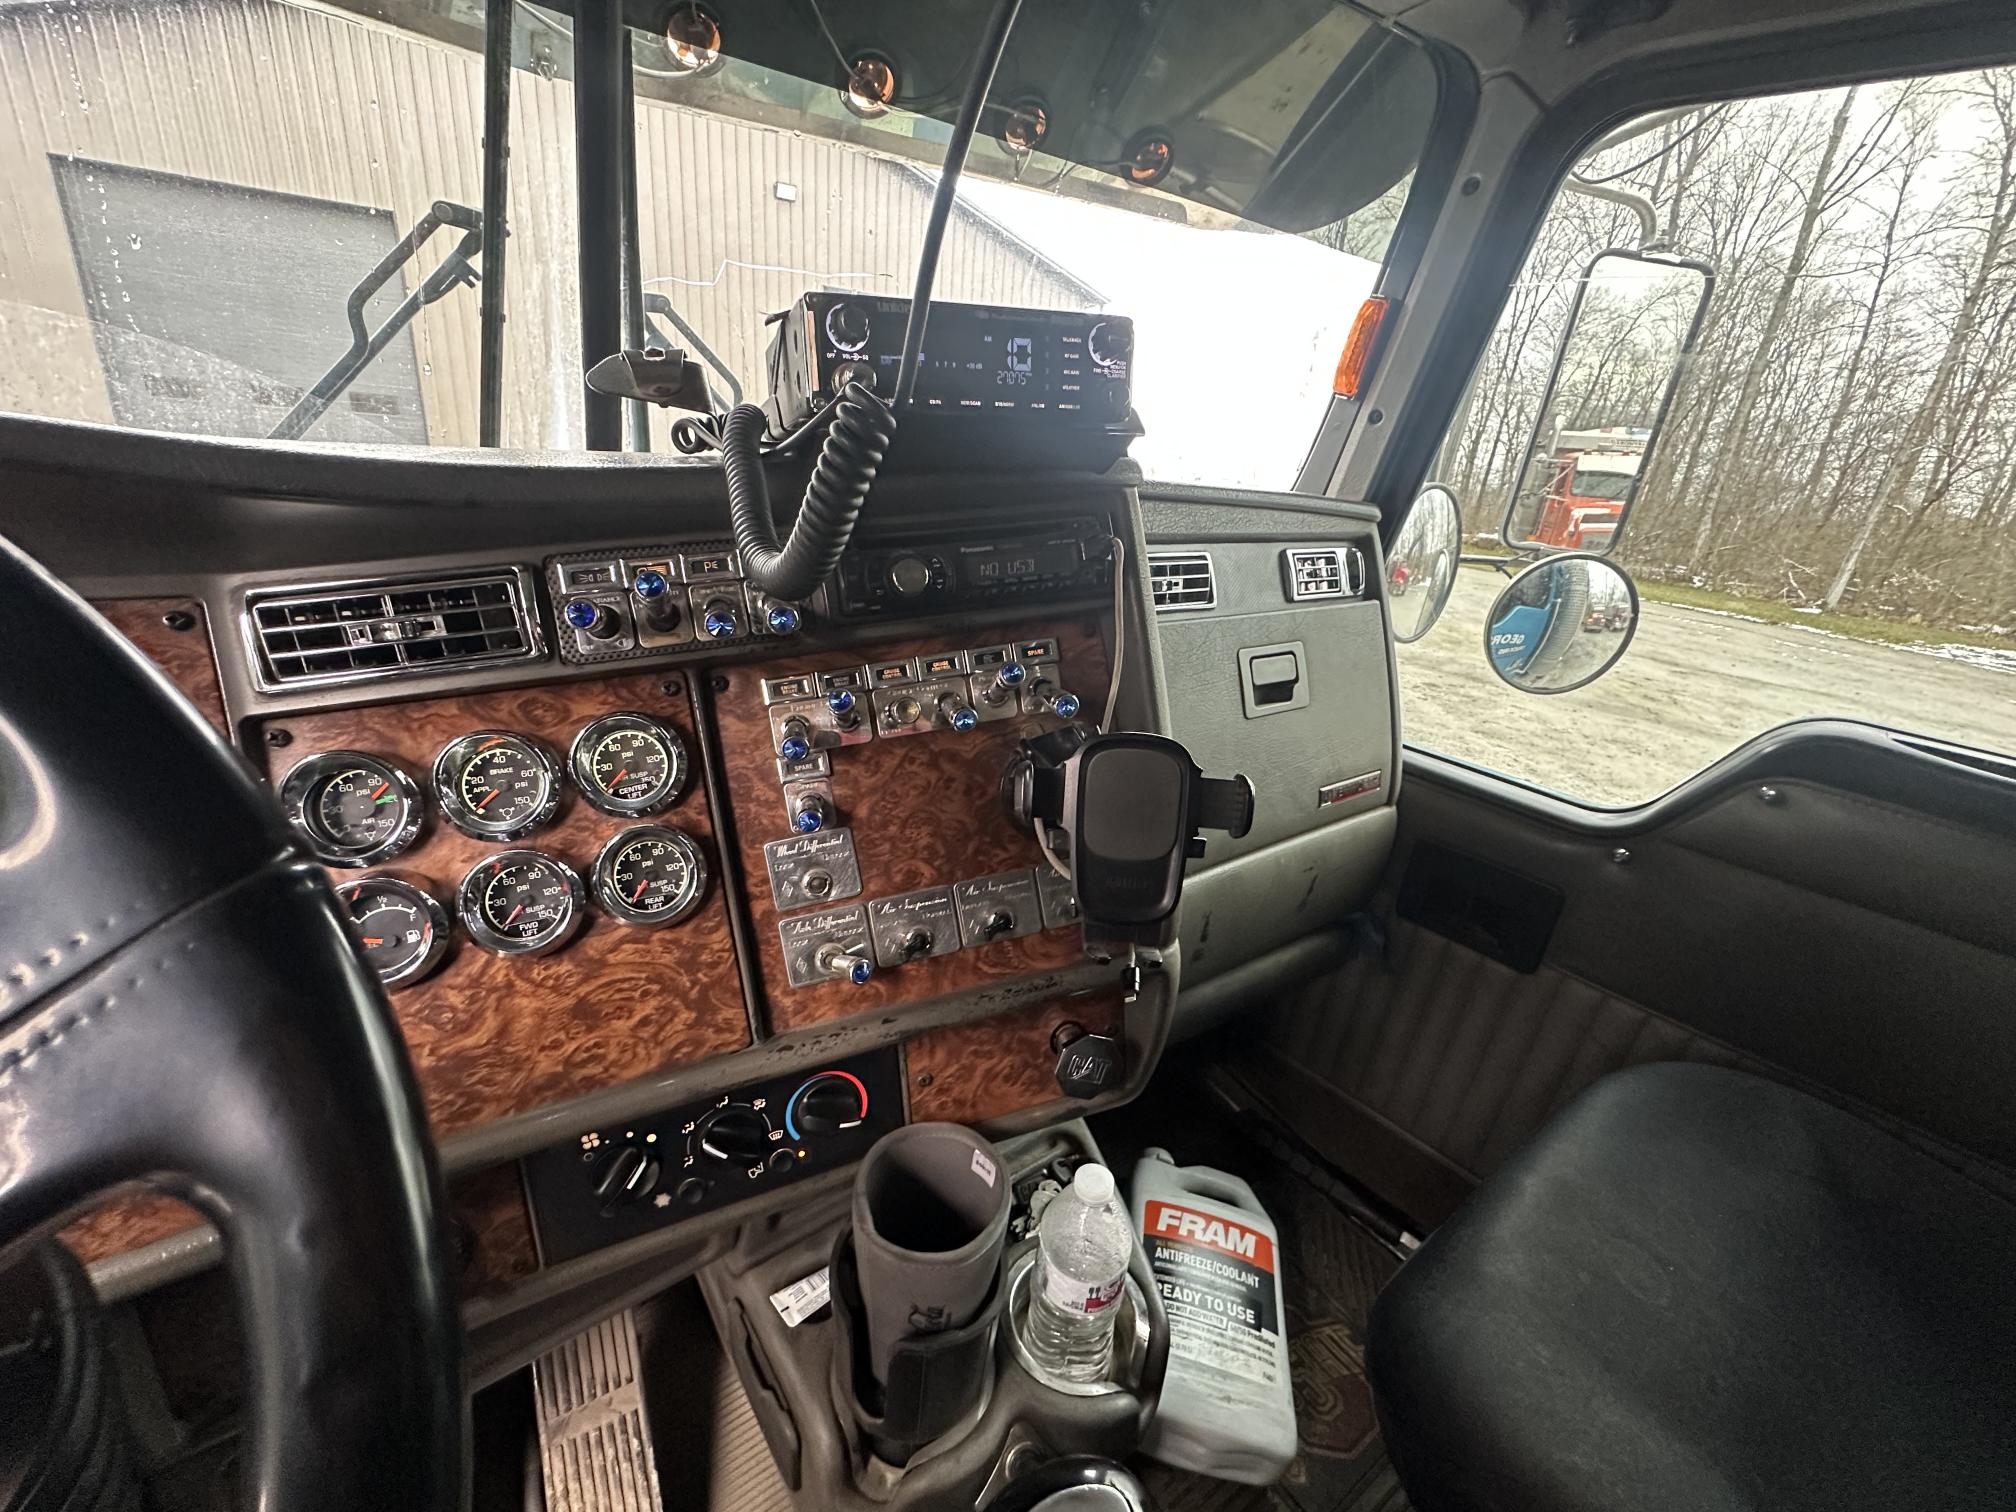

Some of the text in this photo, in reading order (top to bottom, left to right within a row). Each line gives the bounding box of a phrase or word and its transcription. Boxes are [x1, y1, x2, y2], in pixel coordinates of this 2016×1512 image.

[1006, 337, 1032, 372] 10
[608, 743, 621, 752] 60
[631, 739, 645, 748] 90
[492, 755, 506, 764] 40
[621, 751, 634, 760] psi
[646, 754, 661, 763] 120
[489, 766, 514, 776] BRAKE
[600, 762, 613, 772] 30
[794, 763, 813, 772] SPARE
[520, 769, 534, 778] 60
[629, 770, 649, 780] SUSP
[367, 777, 382, 787] 90
[470, 775, 485, 785] 20
[514, 780, 528, 790] psi
[338, 783, 354, 793] 60
[355, 788, 371, 798] psi
[472, 785, 492, 794] APPL
[618, 782, 648, 796] CENTER
[626, 790, 643, 799] LIFT
[513, 795, 531, 806] 150
[361, 816, 376, 825] AIR
[377, 817, 396, 828] 150
[628, 852, 642, 862] 60
[651, 847, 665, 857] 90
[641, 859, 654, 869] psi
[664, 862, 680, 872] 120
[528, 870, 542, 880] 90
[620, 872, 634, 881] 30
[502, 876, 517, 886] 60
[649, 879, 669, 888] SUSP
[516, 882, 531, 893] psi
[542, 886, 559, 896] 120
[660, 883, 676, 893] 150
[493, 897, 508, 907] 30
[644, 895, 666, 905] REAR
[525, 904, 546, 914] SUSP
[648, 902, 664, 911] LIFT
[409, 913, 417, 922] F
[537, 908, 554, 919] 150
[519, 921, 539, 931] FWD
[522, 928, 539, 938] LIFT
[1067, 1054, 1112, 1085] CAT
[1156, 1207, 1257, 1259] FRAM
[1154, 1246, 1260, 1289] ANTIFREEZE/COOLANT
[1204, 1294, 1224, 1313] TO
[1227, 1301, 1256, 1325] USE
